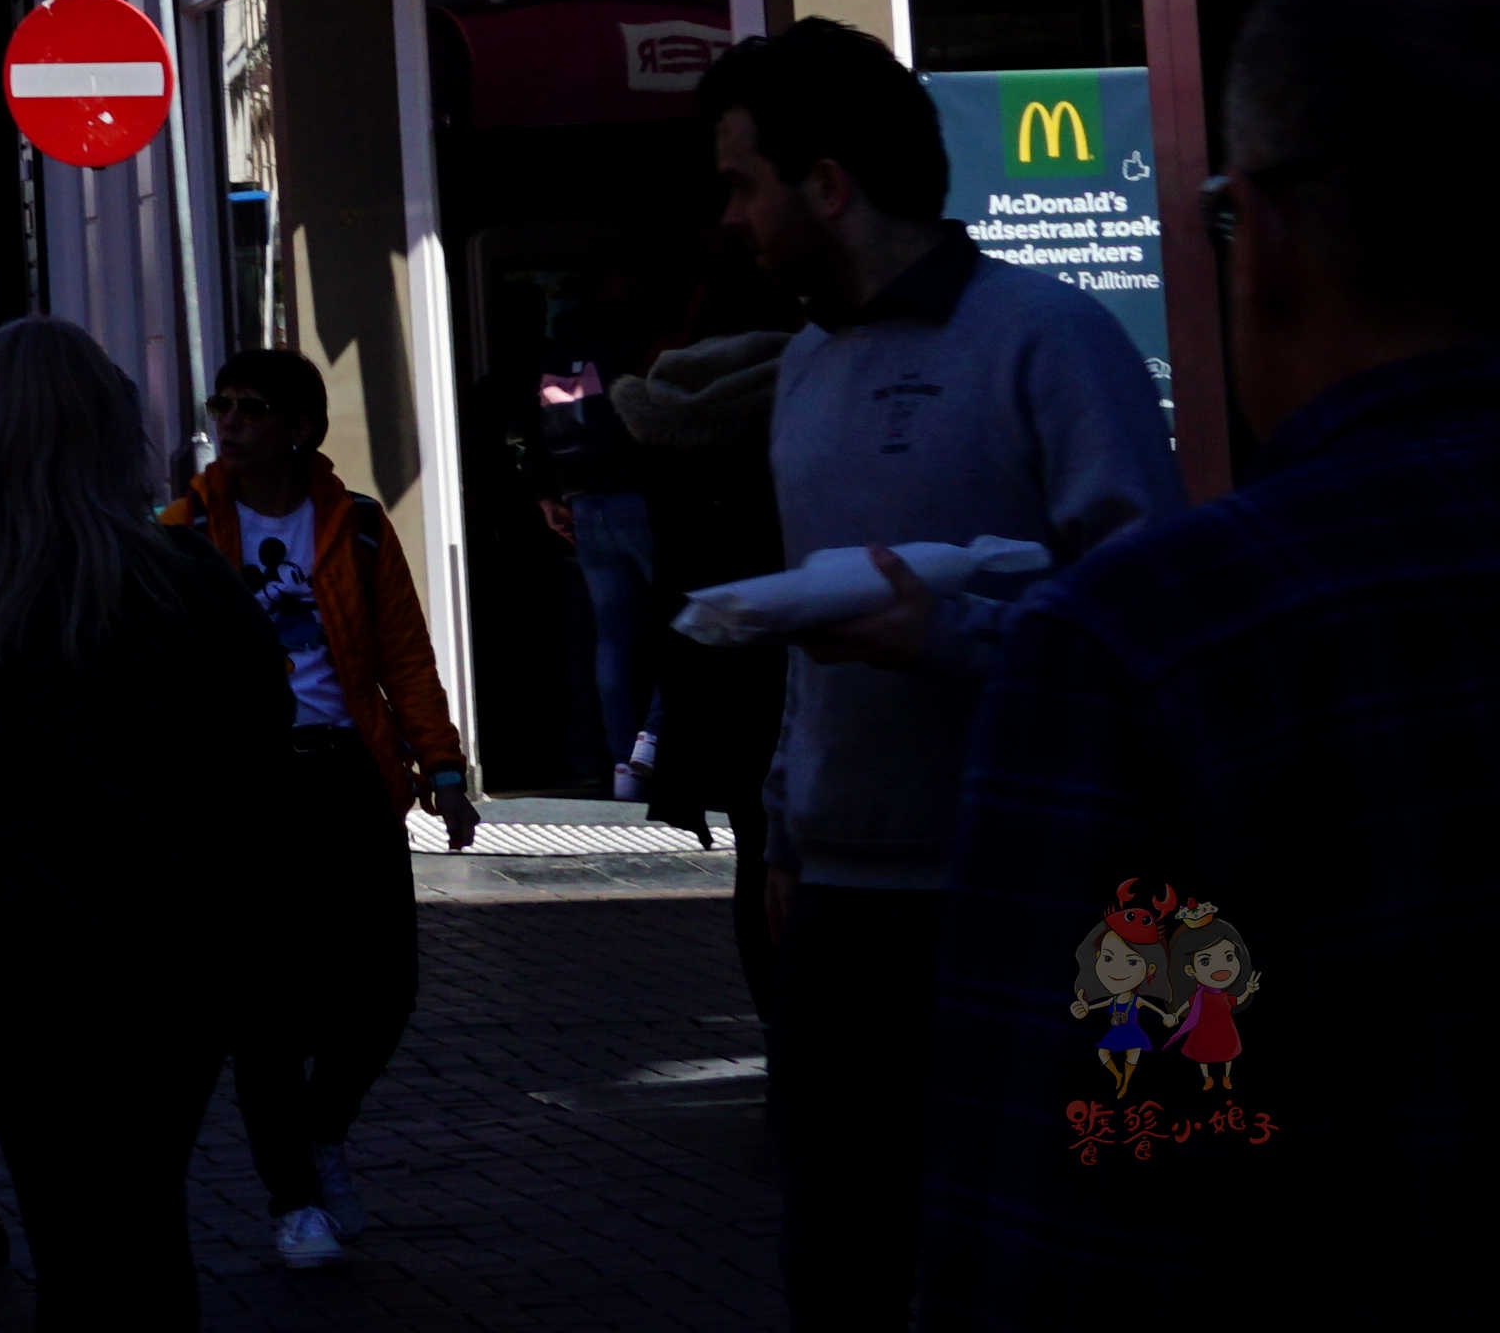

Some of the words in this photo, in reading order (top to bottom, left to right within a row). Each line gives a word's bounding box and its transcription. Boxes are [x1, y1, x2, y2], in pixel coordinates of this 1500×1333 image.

[989, 191, 1128, 215] McDonald's
[965, 218, 1100, 241] eidsestraat
[1101, 216, 1161, 237] zoek
[1077, 270, 1165, 291] Fulltime
